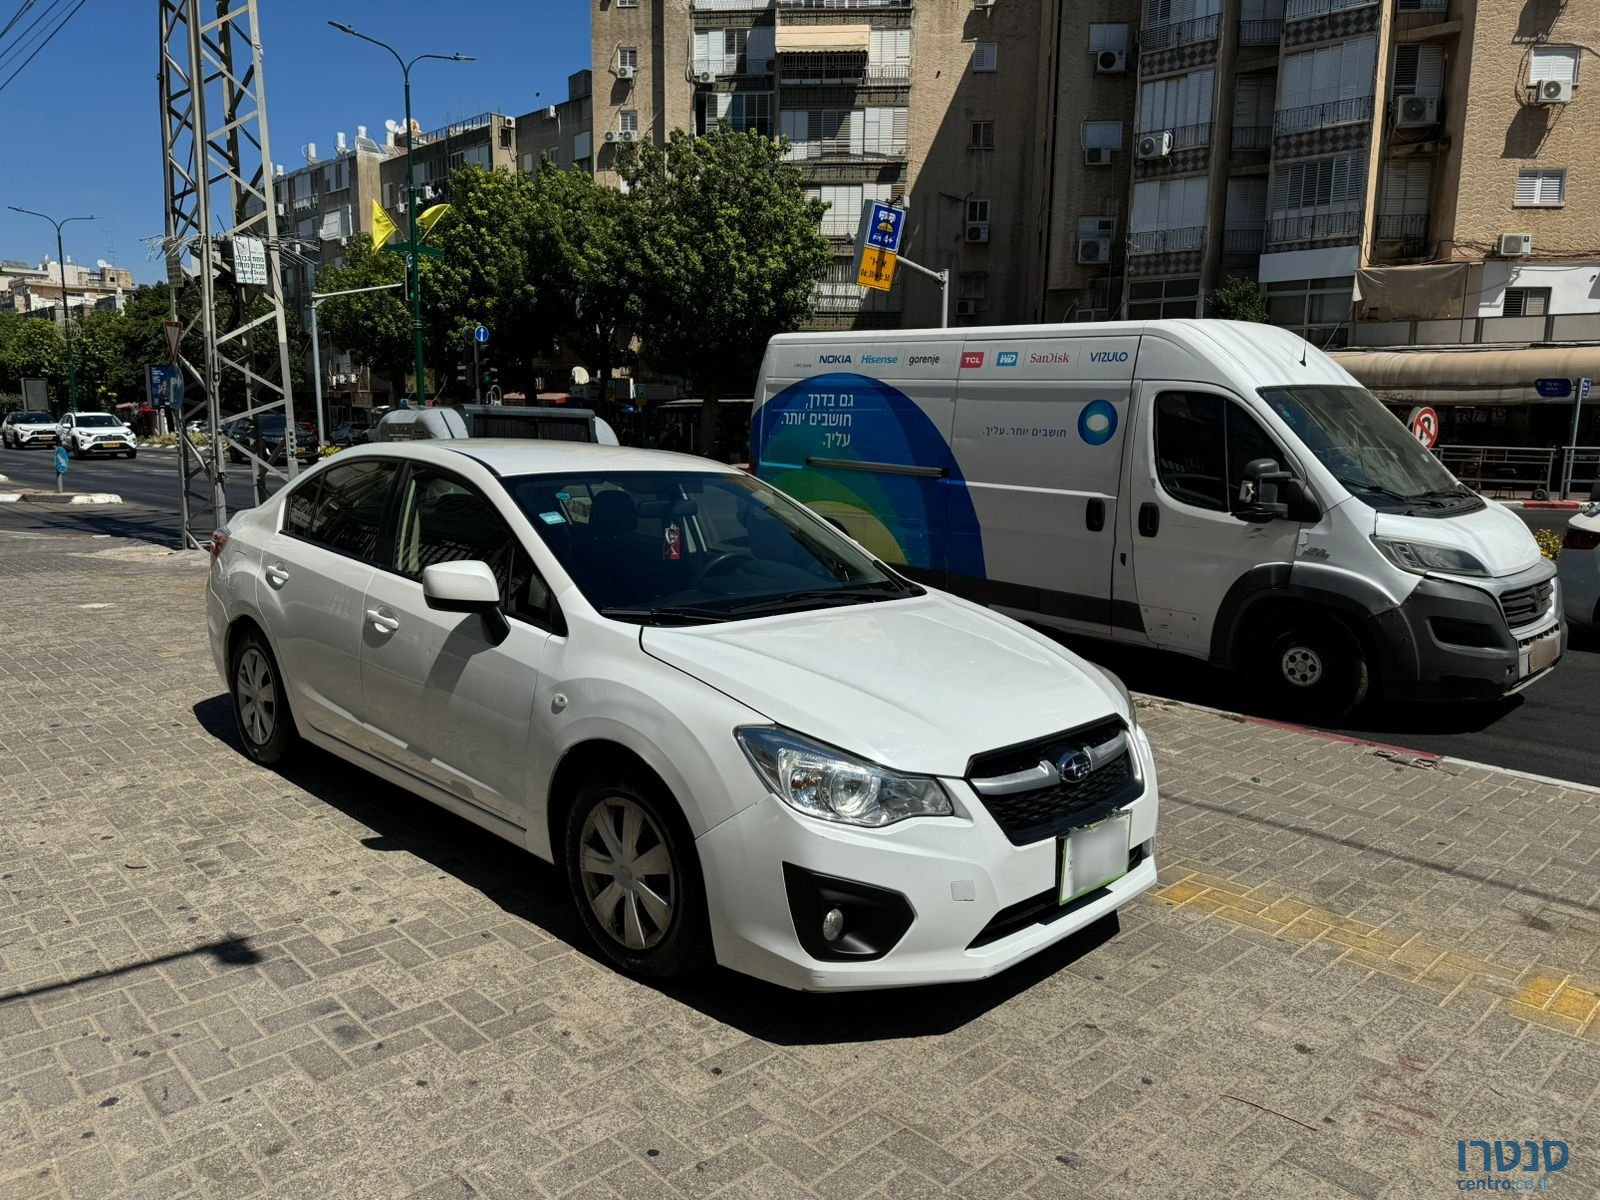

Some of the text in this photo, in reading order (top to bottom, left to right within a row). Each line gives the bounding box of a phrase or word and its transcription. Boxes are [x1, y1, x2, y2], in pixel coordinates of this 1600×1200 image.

[819, 355, 852, 364] NOKIA
[861, 354, 898, 364] Hisense
[908, 354, 940, 366] gorenje
[964, 356, 980, 364] TCL
[1000, 354, 1016, 364] WD
[1030, 352, 1070, 364] SanDisk
[1090, 351, 1128, 362] VIZULO
[805, 394, 854, 409] גם בדרך,
[781, 412, 852, 427] חושבים יותר.
[1032, 427, 1067, 438] חושבים
[822, 431, 851, 448] עליך.
